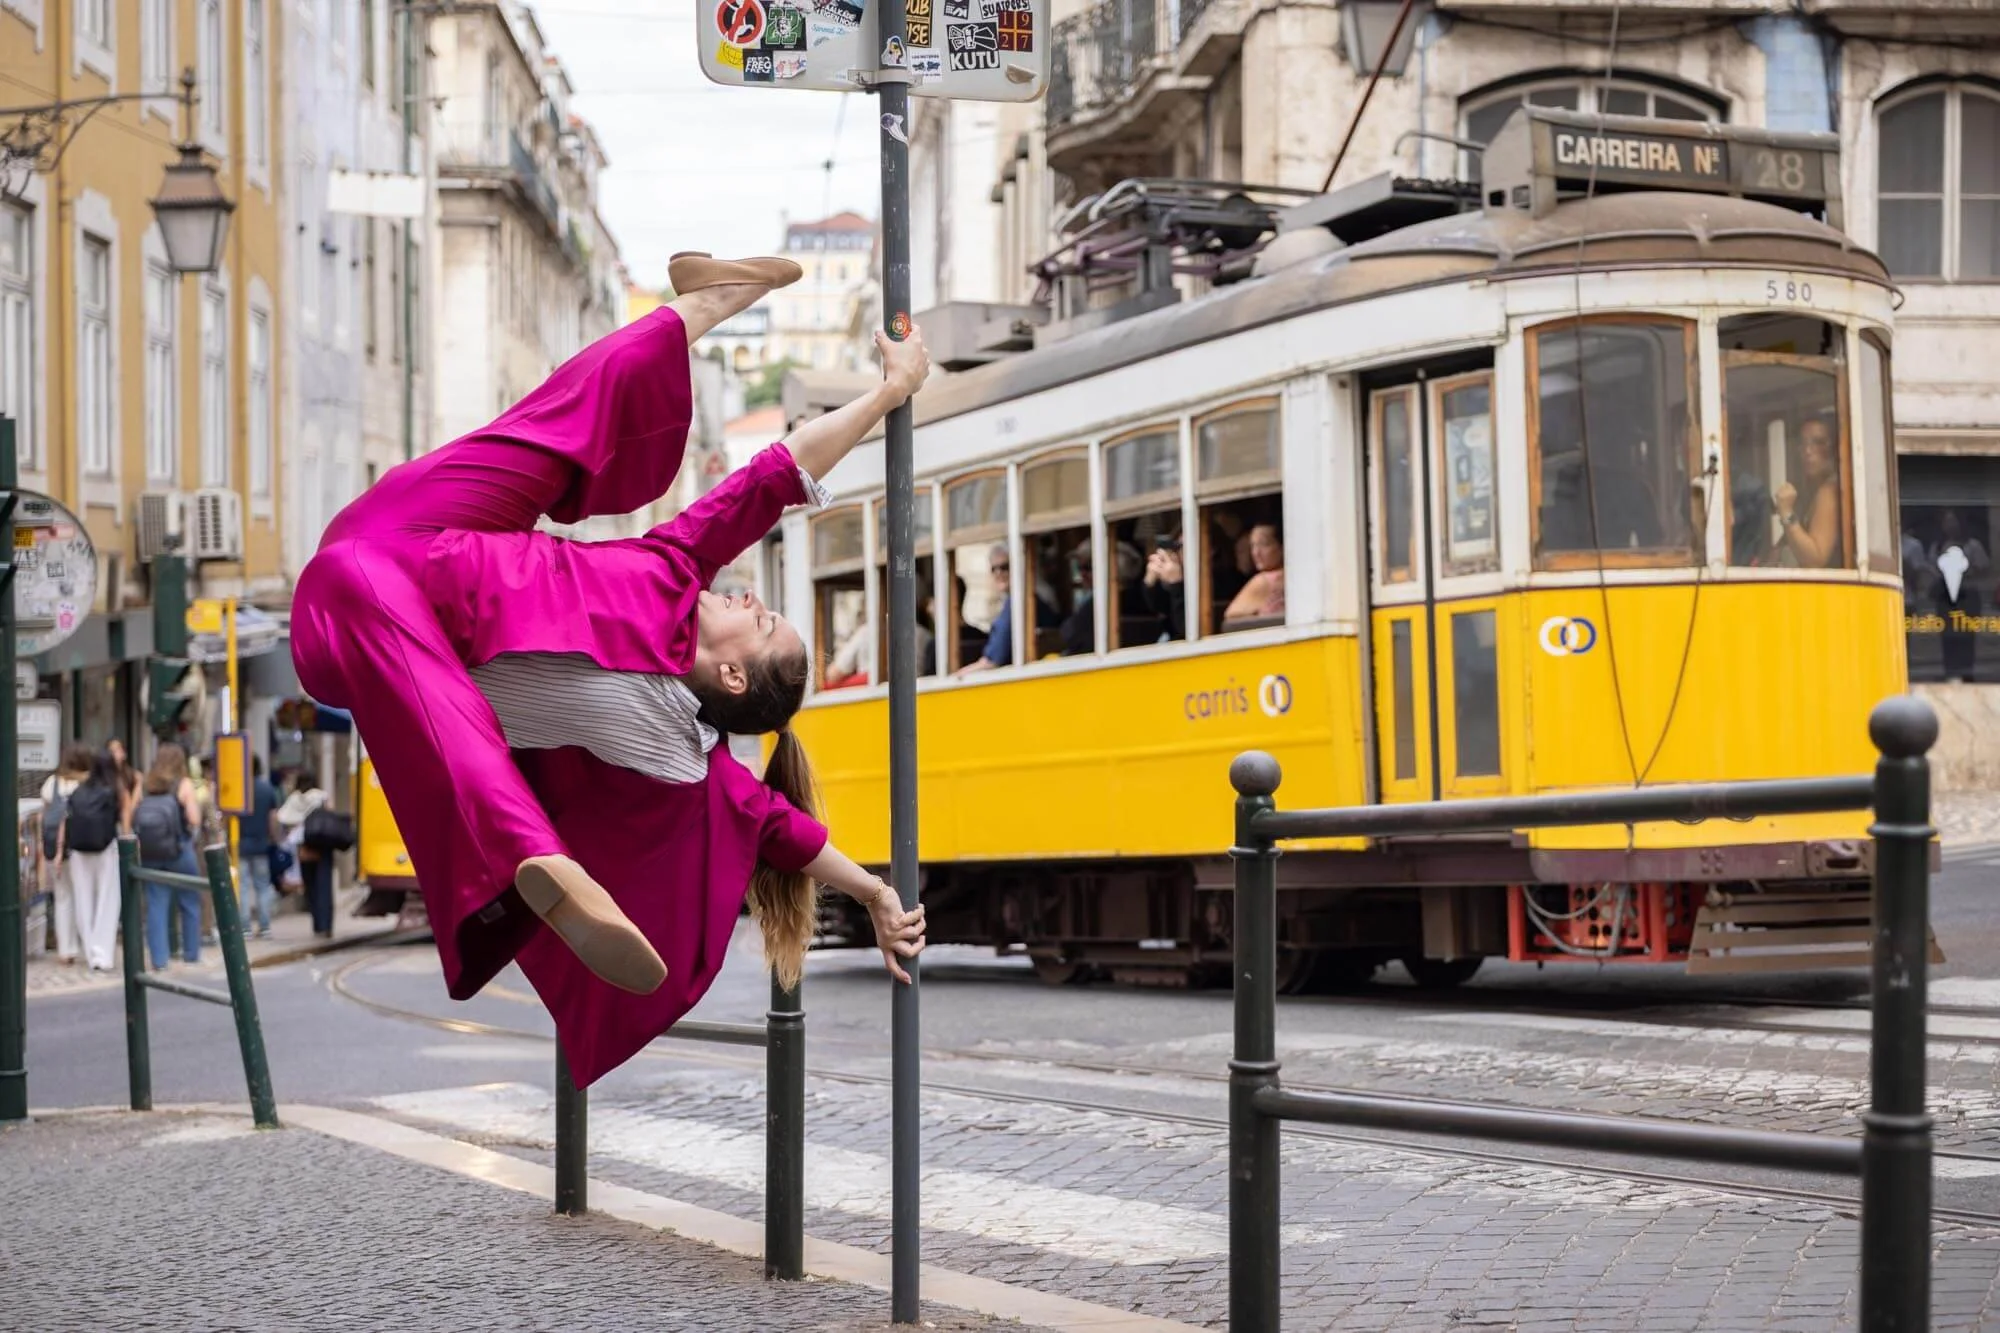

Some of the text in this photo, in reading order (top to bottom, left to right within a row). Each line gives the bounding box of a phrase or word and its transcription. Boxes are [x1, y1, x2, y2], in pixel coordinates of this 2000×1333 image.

[950, 50, 1000, 70] KUTU
[1556, 134, 1682, 173] CARREIRA
[1756, 151, 1805, 191] 28
[1766, 279, 1813, 302] 580
[1904, 612, 1946, 633] elato
[1183, 676, 1249, 720] carris
